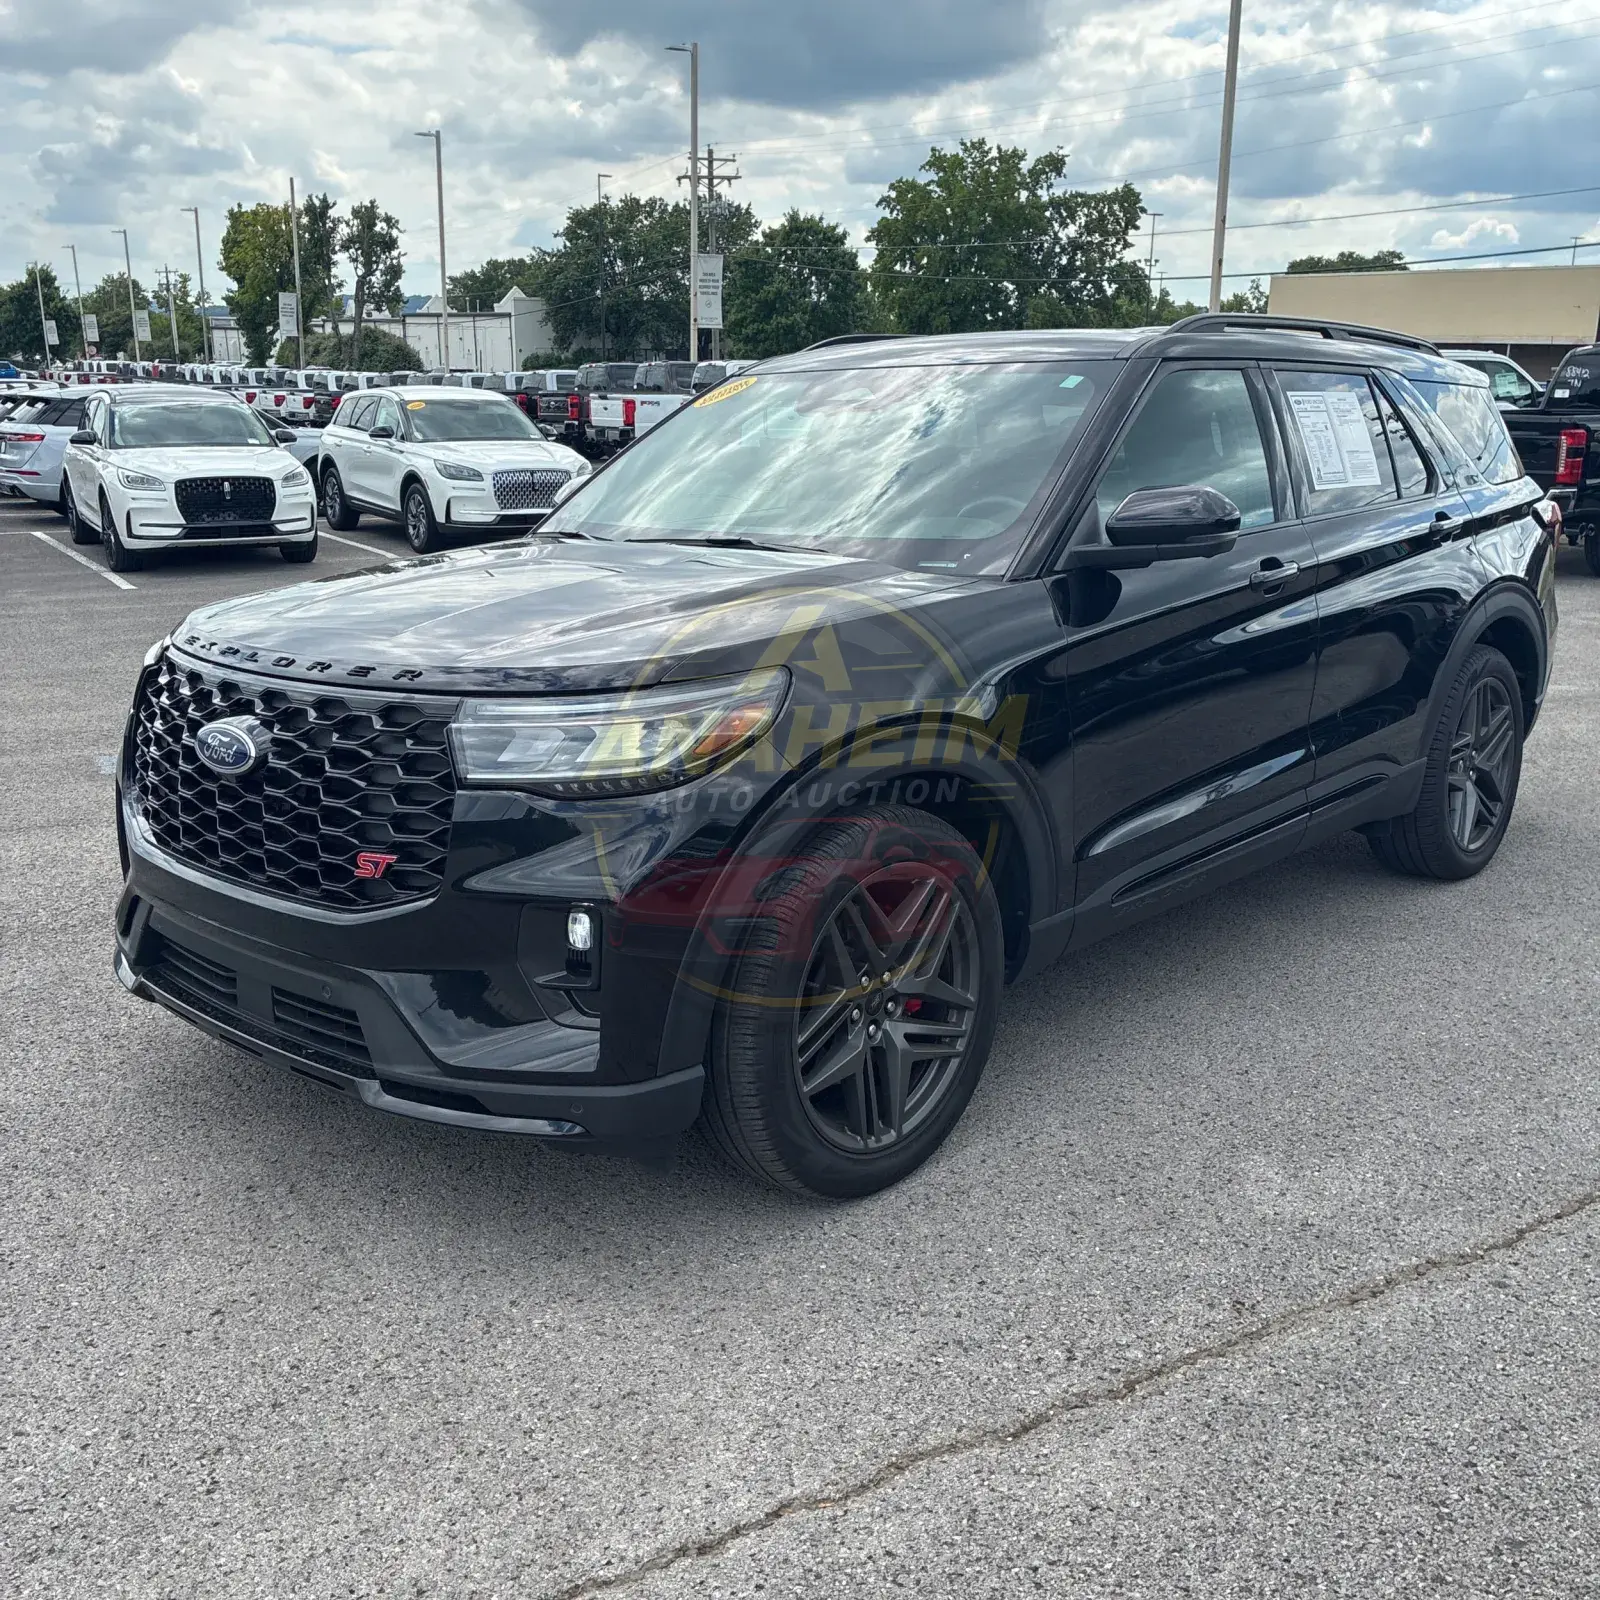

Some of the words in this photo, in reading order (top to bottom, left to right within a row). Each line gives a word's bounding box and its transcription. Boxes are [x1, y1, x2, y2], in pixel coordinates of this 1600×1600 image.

[184, 635, 423, 681] EXPLORER
[203, 732, 237, 763] Ford
[354, 852, 398, 878] ST
